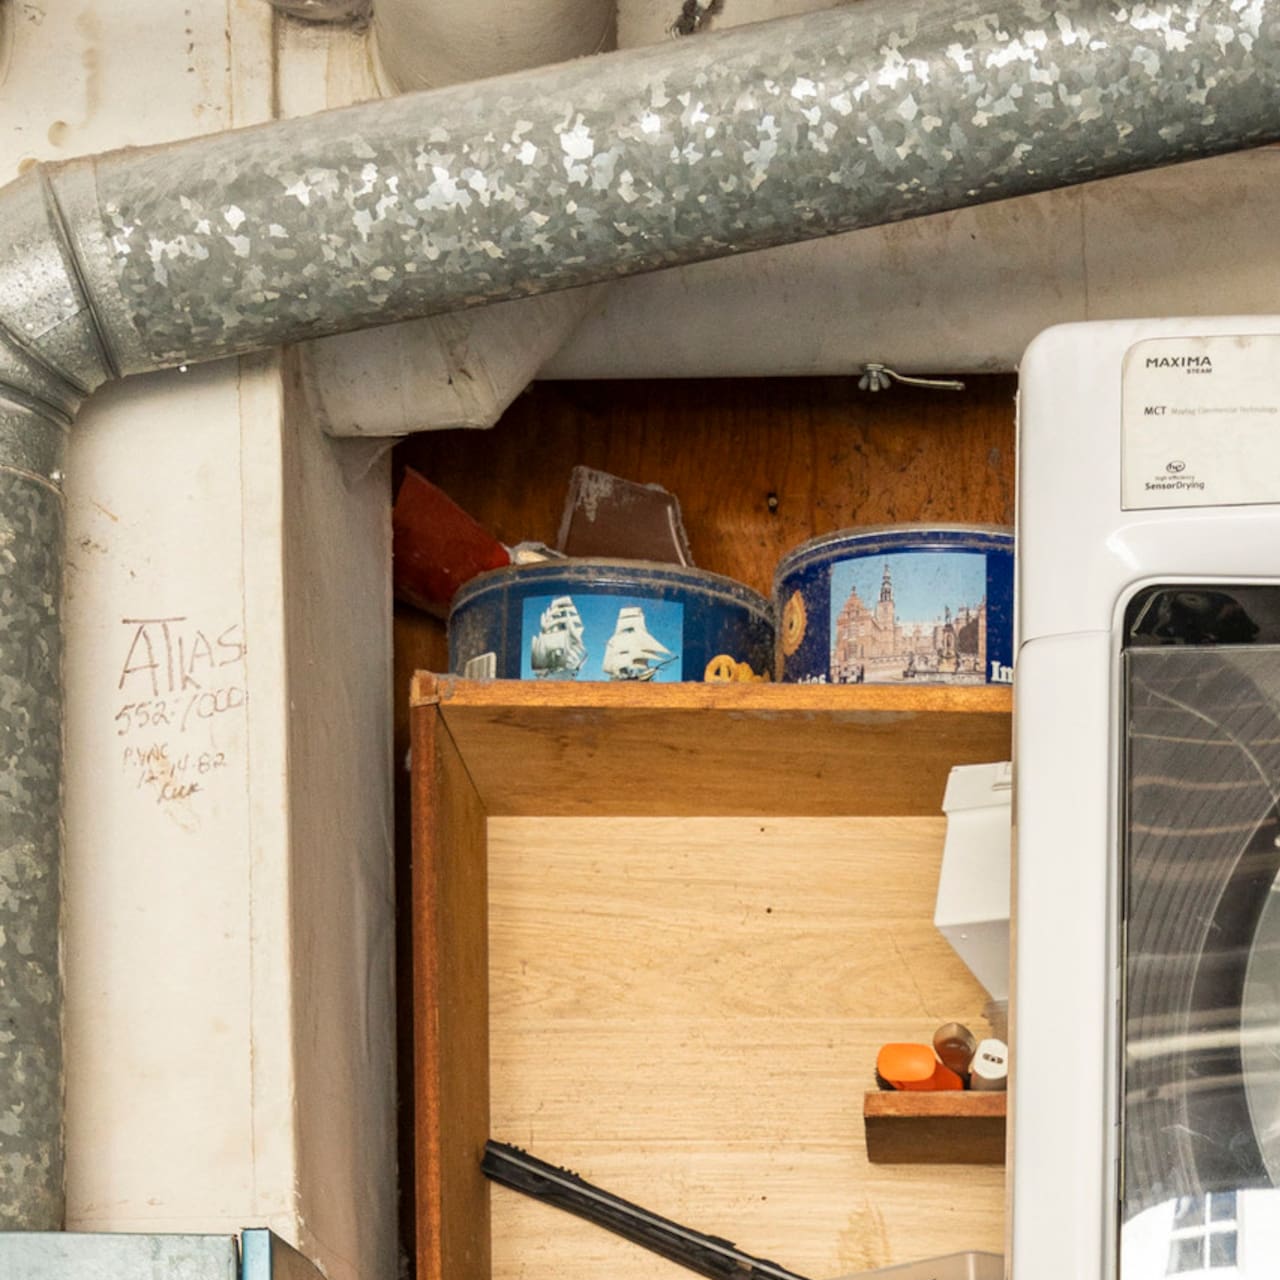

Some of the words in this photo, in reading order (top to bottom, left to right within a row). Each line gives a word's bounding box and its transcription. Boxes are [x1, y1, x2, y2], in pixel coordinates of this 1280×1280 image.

[1145, 356, 1212, 368] MAXIMA
[1144, 406, 1167, 416] MCT
[1144, 480, 1205, 491] SensorDrying
[118, 617, 244, 696] ATLAS
